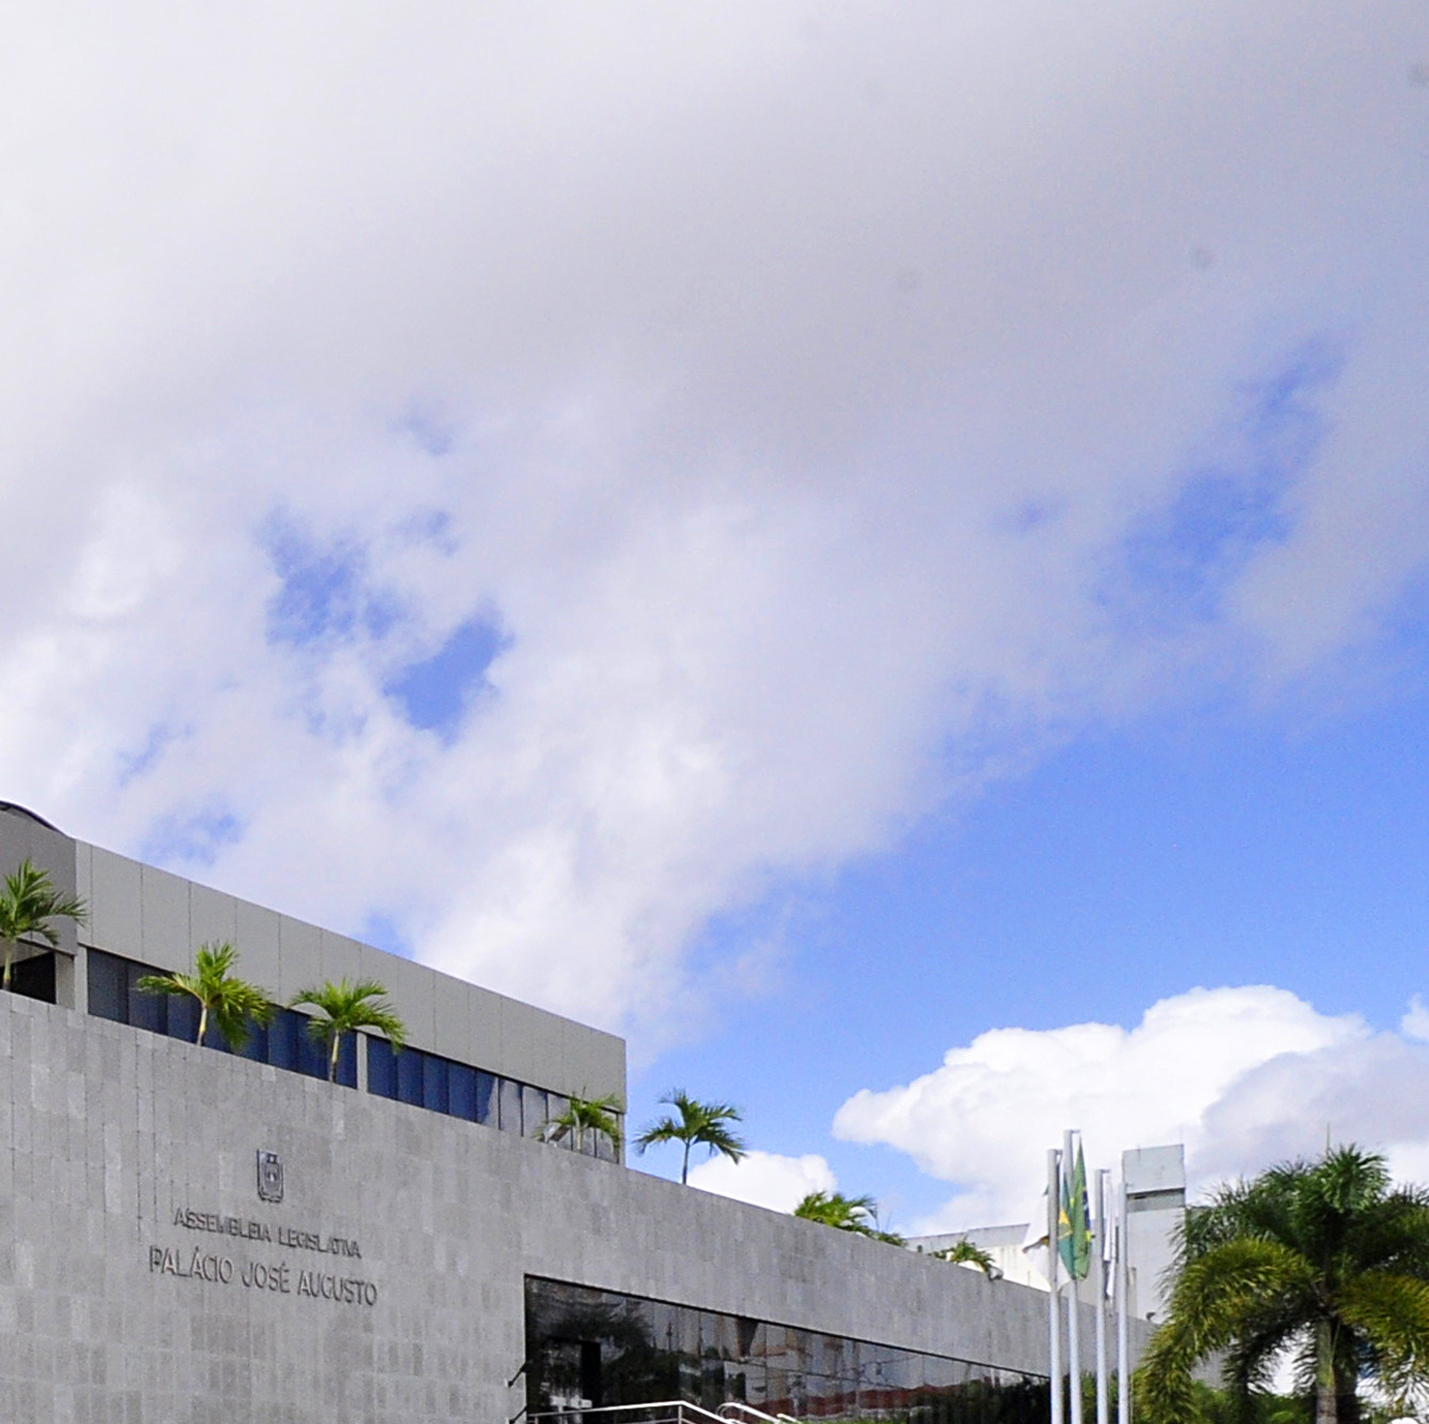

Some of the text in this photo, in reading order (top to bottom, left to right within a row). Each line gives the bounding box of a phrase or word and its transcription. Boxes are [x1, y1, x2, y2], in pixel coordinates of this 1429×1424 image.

[278, 1226, 362, 1260] LEGISLATIVA
[149, 1245, 378, 1306] PALÁCIO JOSÉ AUGUSTO
